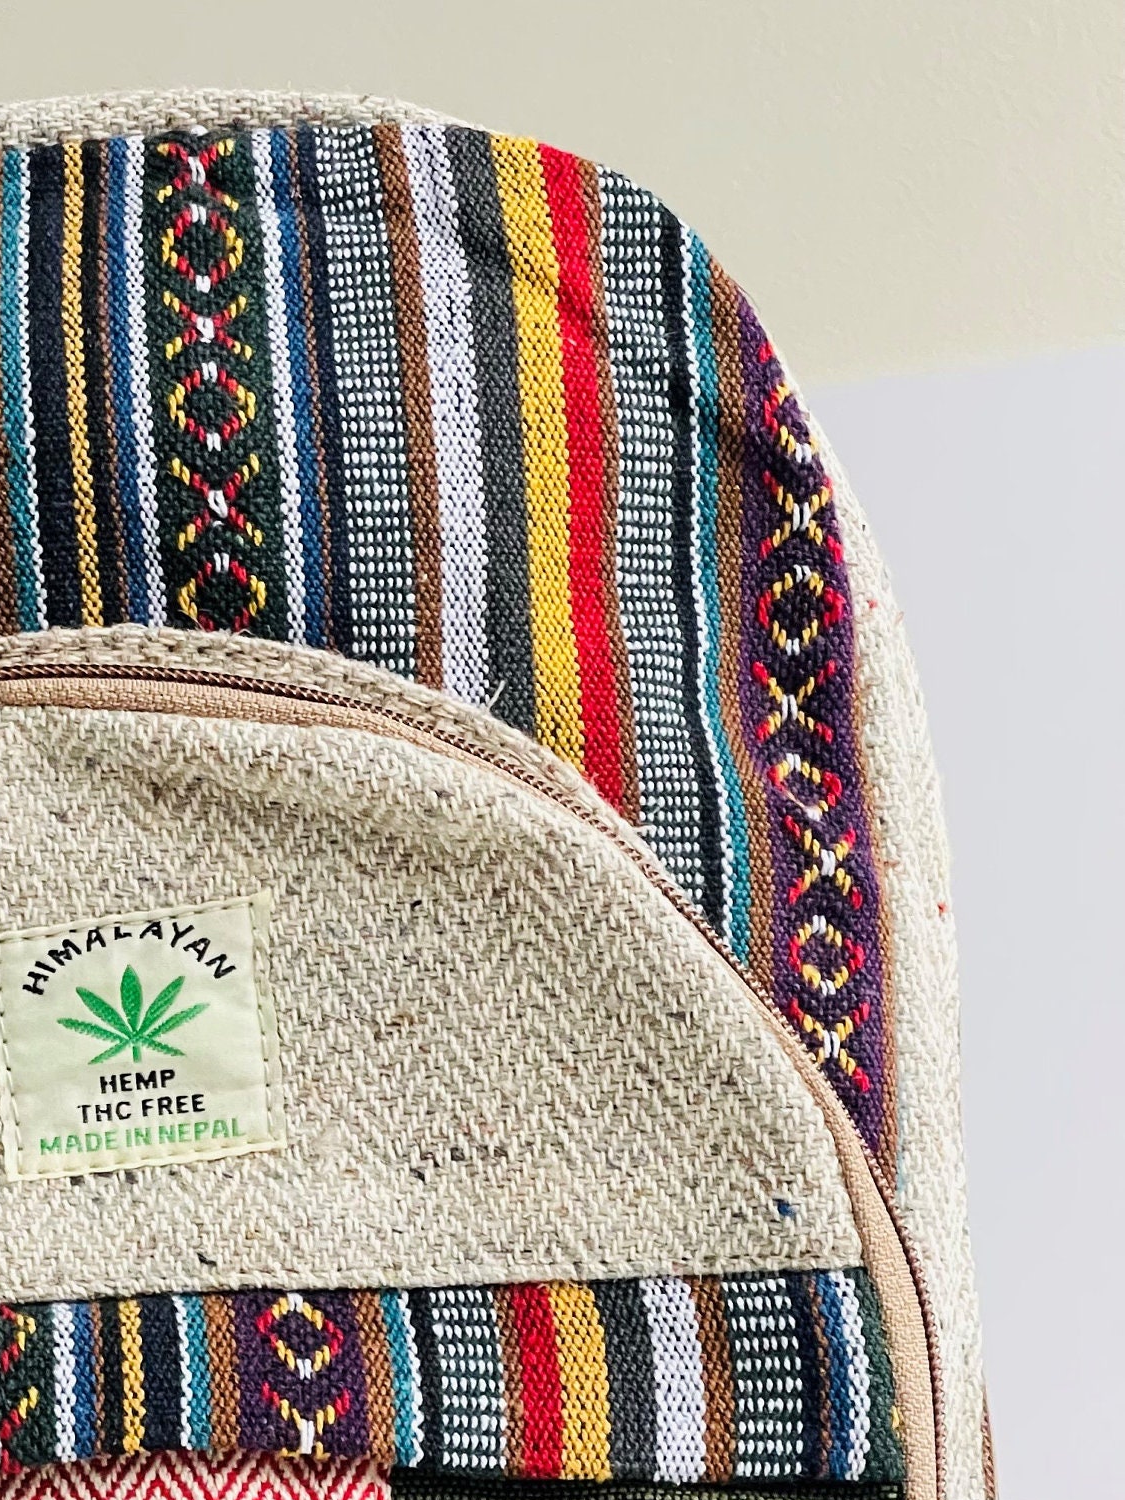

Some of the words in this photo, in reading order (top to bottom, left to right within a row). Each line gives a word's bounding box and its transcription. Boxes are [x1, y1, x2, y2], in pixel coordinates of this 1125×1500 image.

[22, 921, 236, 996] HIMALAYAN
[99, 1069, 176, 1094] HEMP
[77, 1101, 132, 1123] THC
[141, 1093, 206, 1117] FREE
[39, 1130, 119, 1156] MADE
[125, 1125, 152, 1148] IN
[158, 1117, 247, 1145] NEPAL
